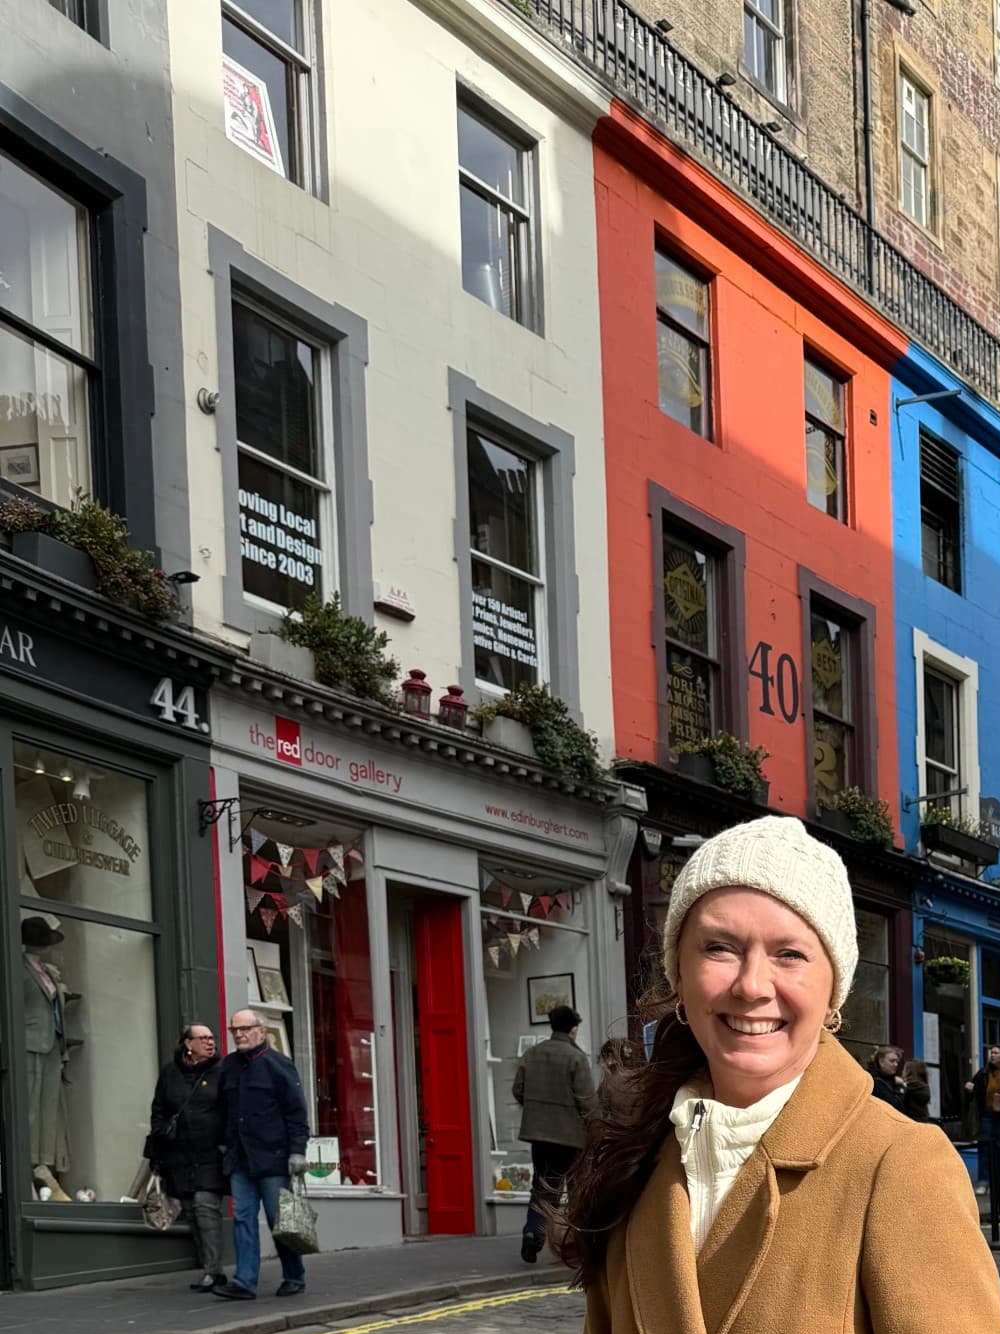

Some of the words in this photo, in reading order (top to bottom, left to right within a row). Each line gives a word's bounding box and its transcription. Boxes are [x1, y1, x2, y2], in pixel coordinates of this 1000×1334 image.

[280, 504, 316, 539] Local
[248, 518, 275, 545] and
[276, 536, 324, 566] Design
[279, 553, 314, 586] 2003
[497, 628, 536, 654] Homeware
[500, 615, 535, 641] Jewellery,
[493, 640, 511, 658] Gifts
[816, 652, 837, 674] BEST
[749, 641, 799, 724] 40
[249, 723, 275, 750] the
[277, 736, 300, 758] red
[304, 741, 342, 770] door
[349, 759, 402, 793] gallery
[31, 803, 78, 839] TWEED
[82, 805, 142, 864] LUGGAGE
[484, 804, 589, 840] www.edinburghart.com
